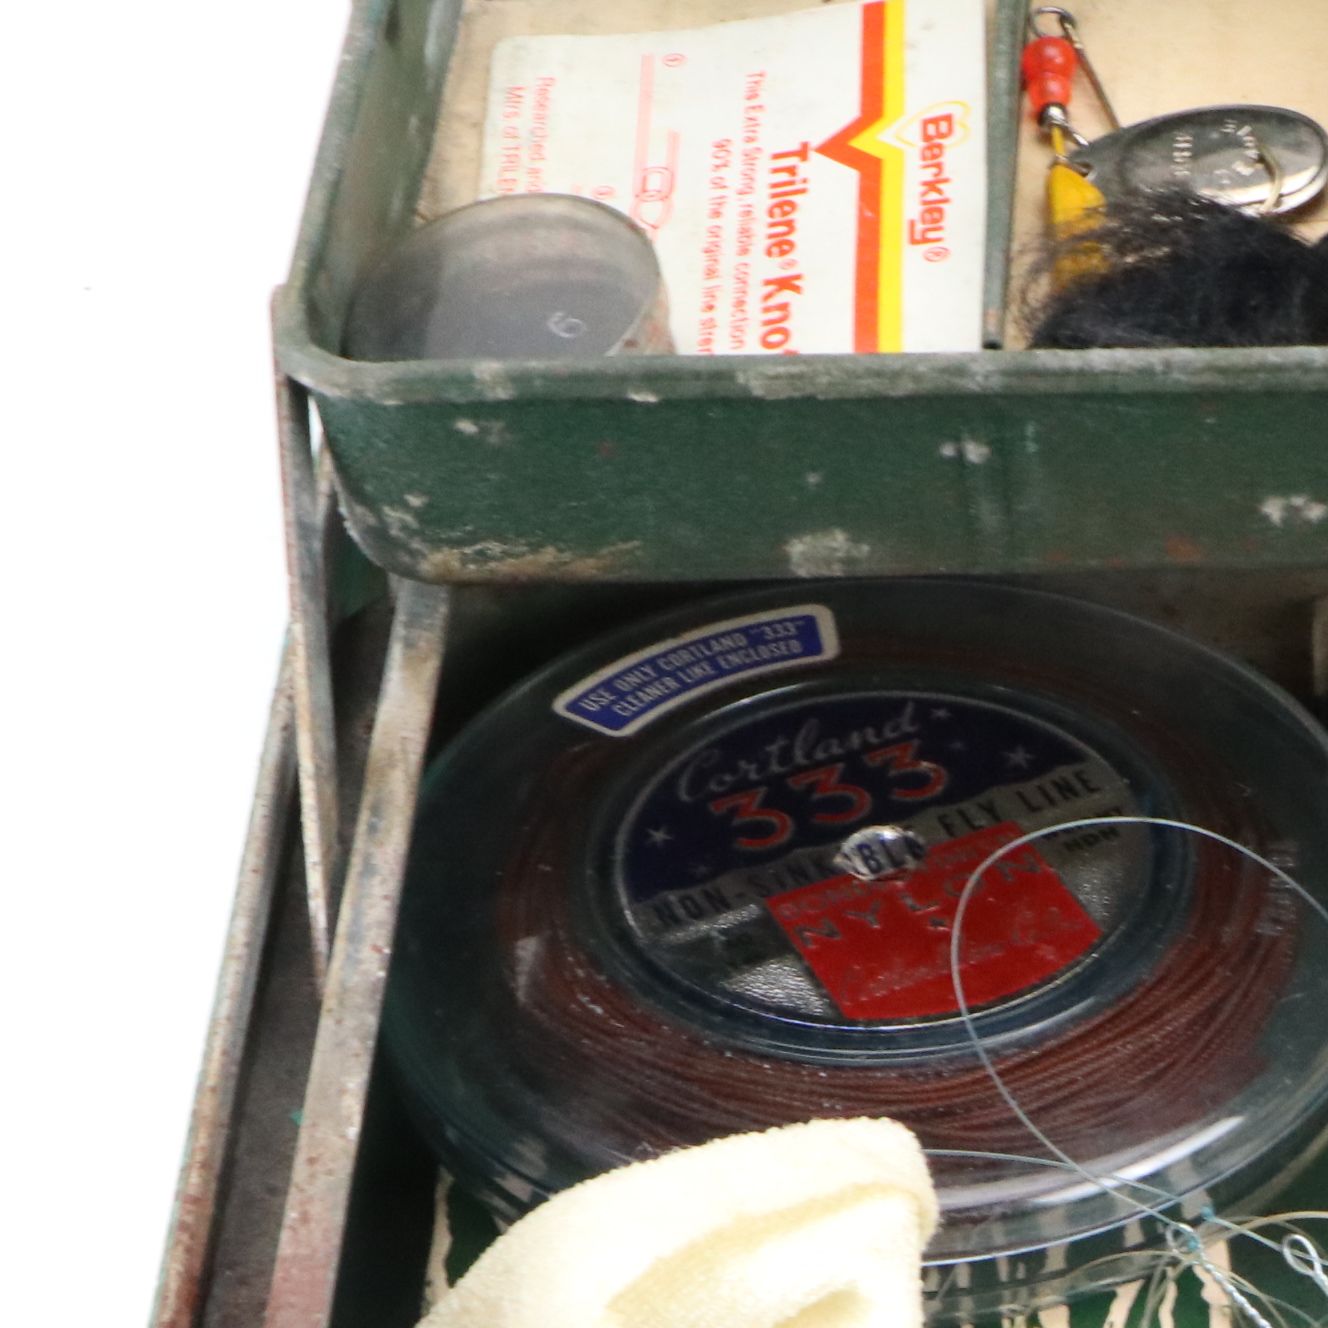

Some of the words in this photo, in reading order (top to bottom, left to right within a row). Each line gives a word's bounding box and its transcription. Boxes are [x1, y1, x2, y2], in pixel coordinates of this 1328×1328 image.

[744, 71, 766, 98] This
[709, 137, 733, 174] 90%
[740, 104, 765, 145] Extra
[706, 176, 731, 191] of
[706, 195, 731, 220] the
[698, 224, 729, 281] original
[735, 204, 764, 258] reliable
[699, 284, 726, 314] line
[728, 262, 760, 351] connection
[758, 273, 808, 354] Kno
[577, 687, 617, 713] USE
[612, 664, 659, 692] ONLY
[655, 631, 749, 672] CORTLAND
[611, 676, 677, 718] CLEANER
[678, 662, 715, 684] LIKE
[717, 639, 803, 670] ENCLOSED
[676, 699, 922, 803] Cortland
[707, 739, 951, 851] 333
[935, 796, 1005, 842] FLY
[1018, 767, 1102, 818] LINE
[794, 851, 1044, 950] NYLON
